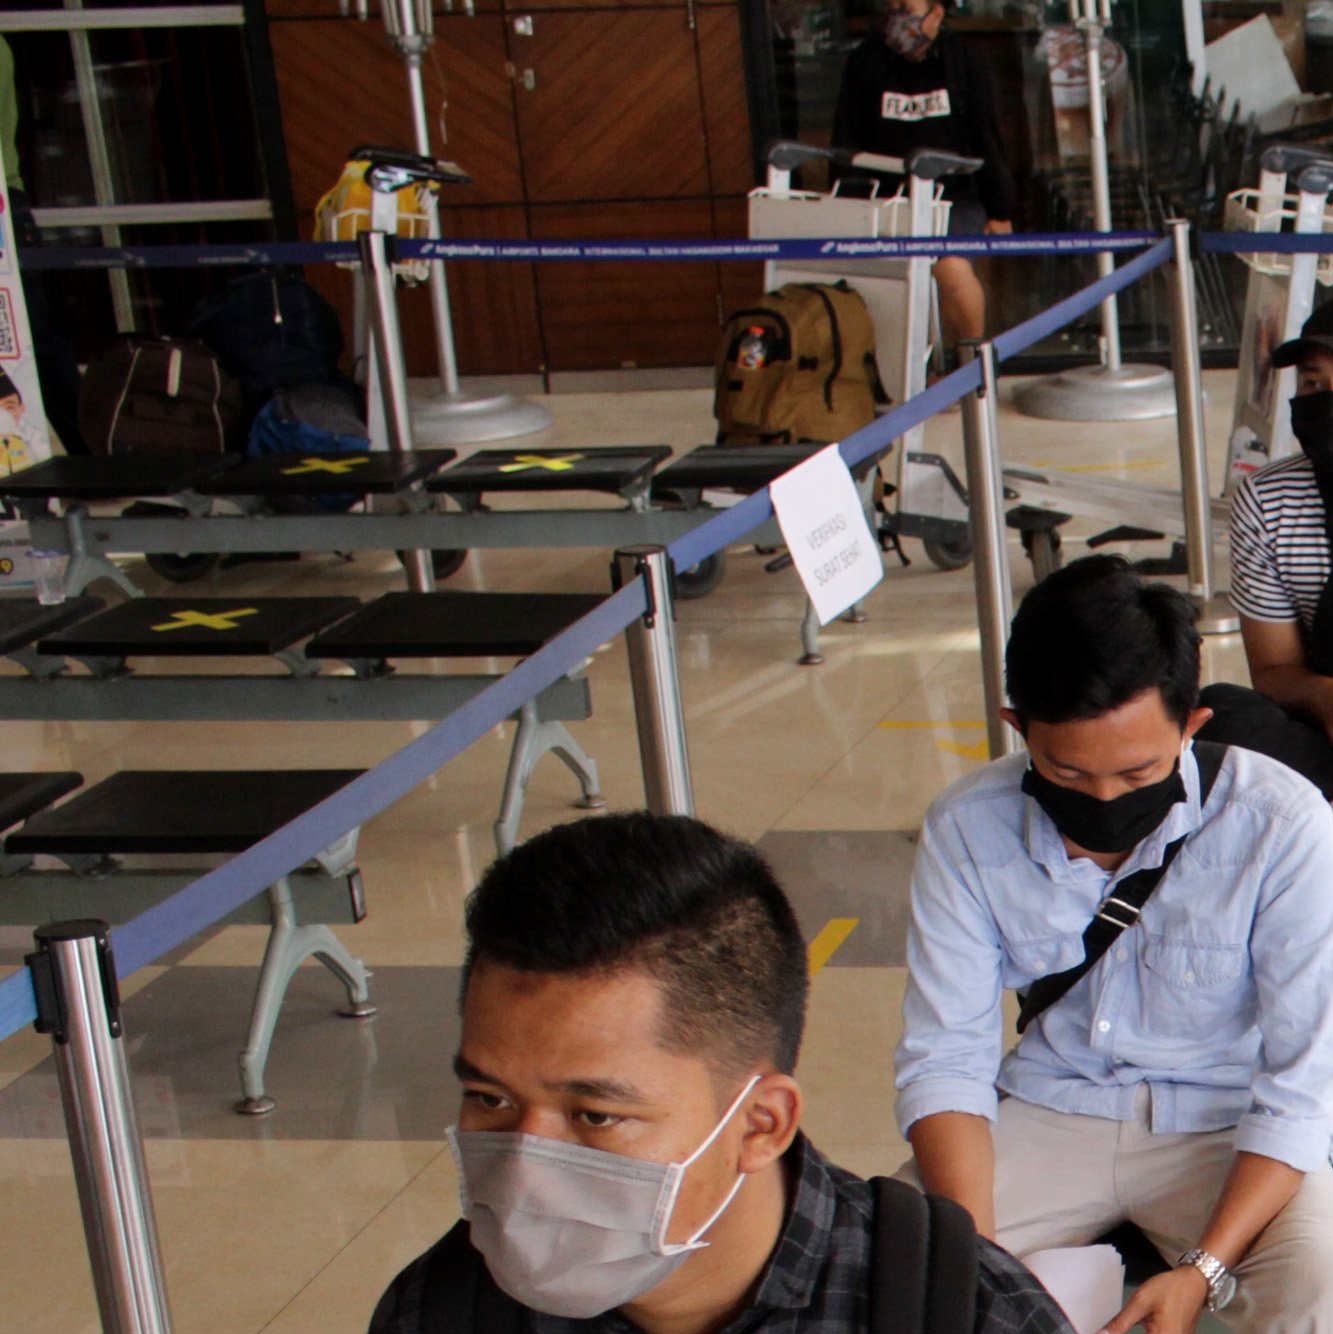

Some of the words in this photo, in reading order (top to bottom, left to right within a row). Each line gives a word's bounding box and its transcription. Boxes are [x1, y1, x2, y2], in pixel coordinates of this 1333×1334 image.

[435, 244, 496, 257] AngkasaPura
[501, 246, 539, 256] AIRPORTS
[540, 246, 582, 256] BANDARA
[836, 241, 900, 254] AngkasaPura
